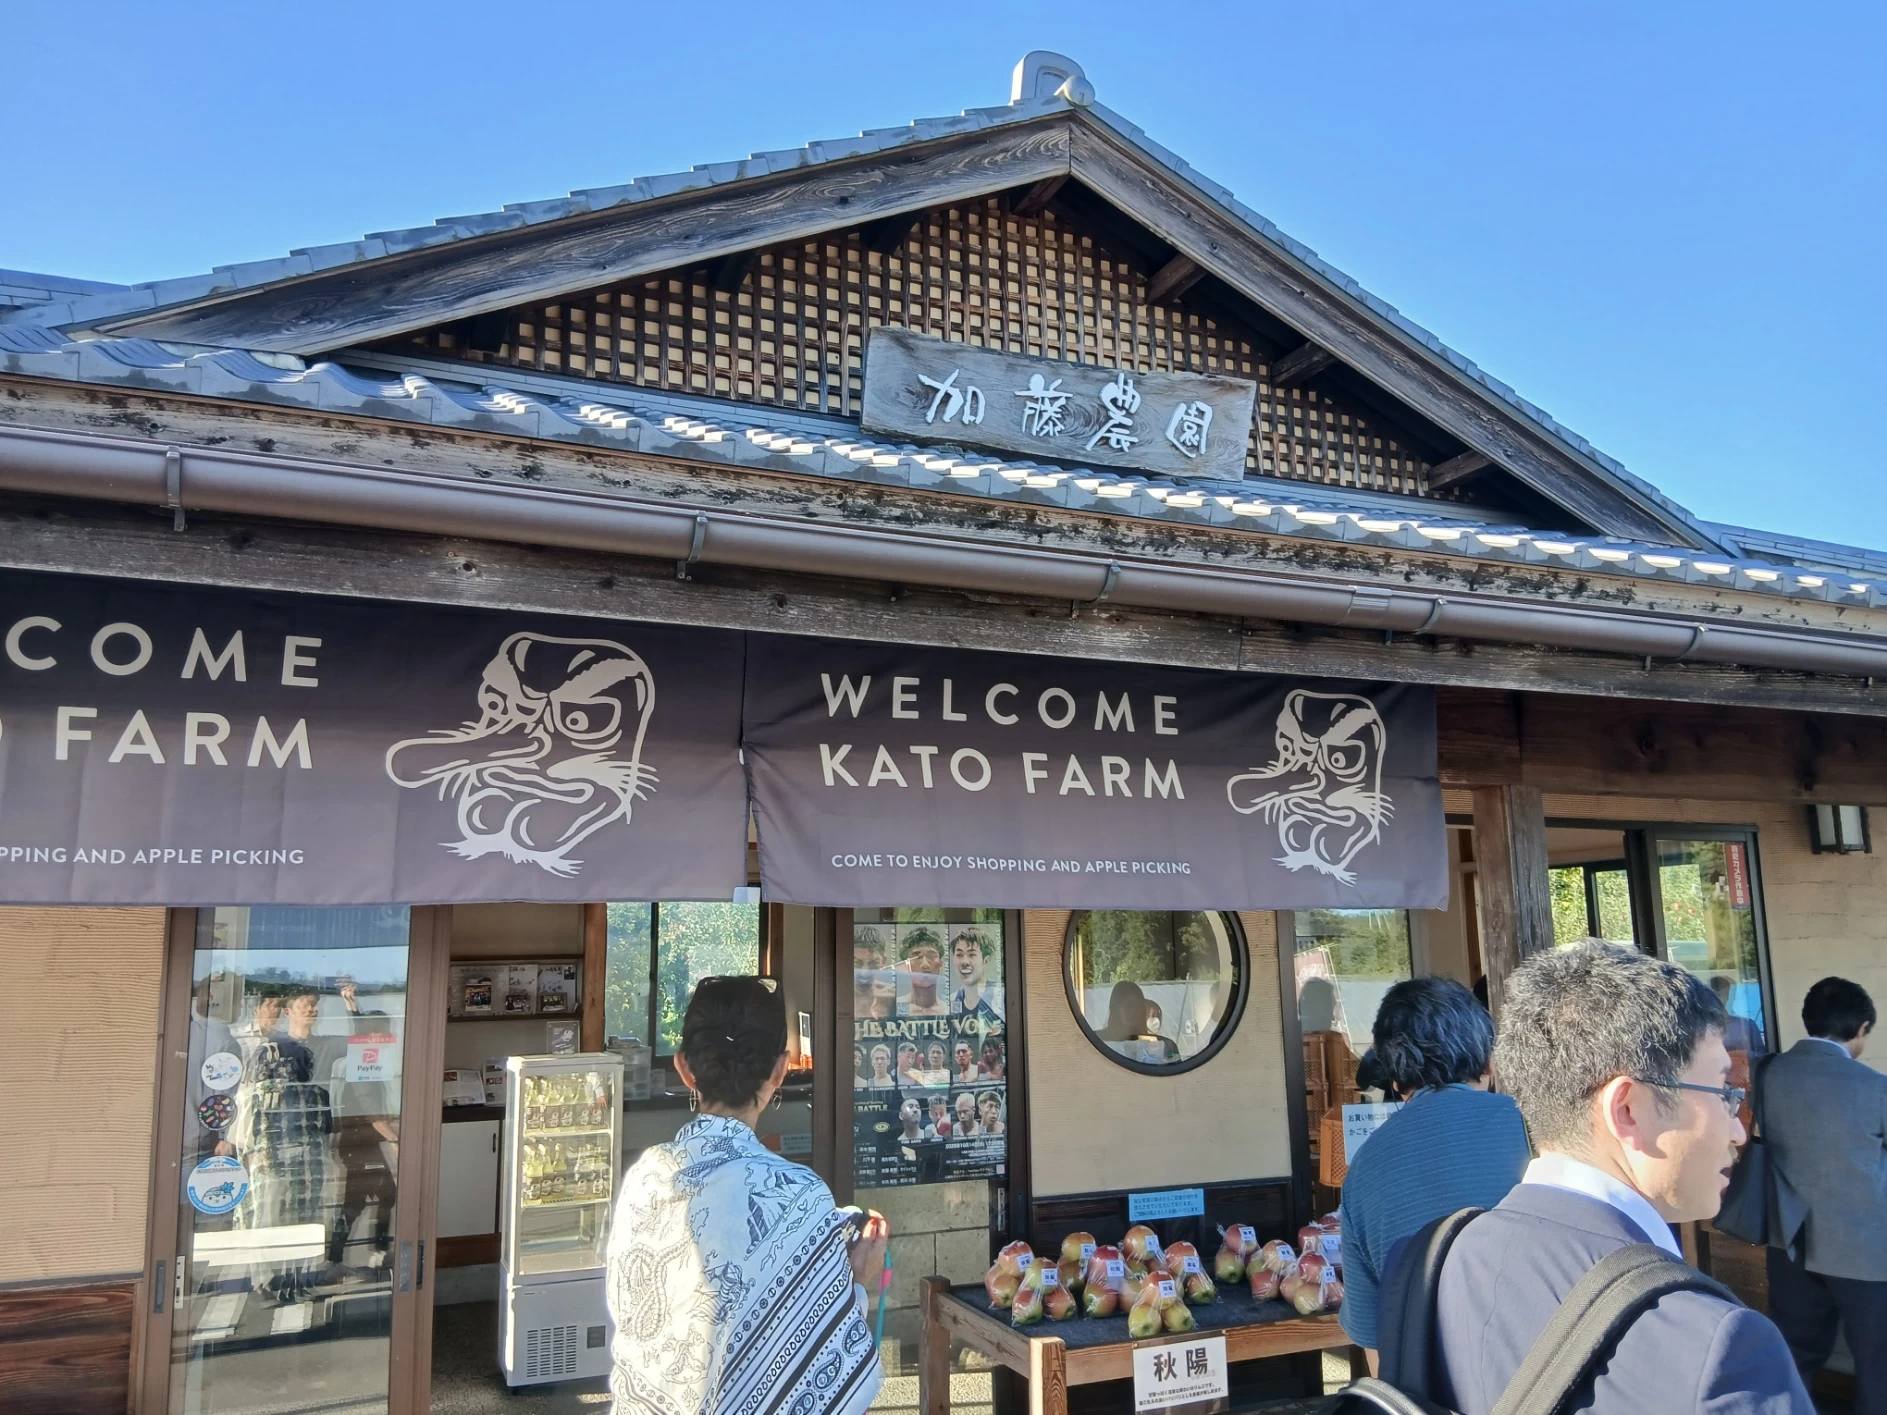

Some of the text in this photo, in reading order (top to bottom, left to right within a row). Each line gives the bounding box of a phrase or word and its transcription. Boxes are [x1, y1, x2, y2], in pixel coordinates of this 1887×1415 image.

[820, 673, 1179, 735] WELCOME
[55, 706, 313, 769] FARM
[819, 743, 1185, 800] KATO FARM
[73, 847, 126, 865] AND
[132, 848, 203, 865] APPLE
[210, 849, 304, 865] PICKING
[831, 854, 1191, 875] COME TO ENJOY SHOPPING AND APPLE PICKING
[884, 1019, 950, 1040] BATTLE
[1153, 1347, 1208, 1382] 秋陽
